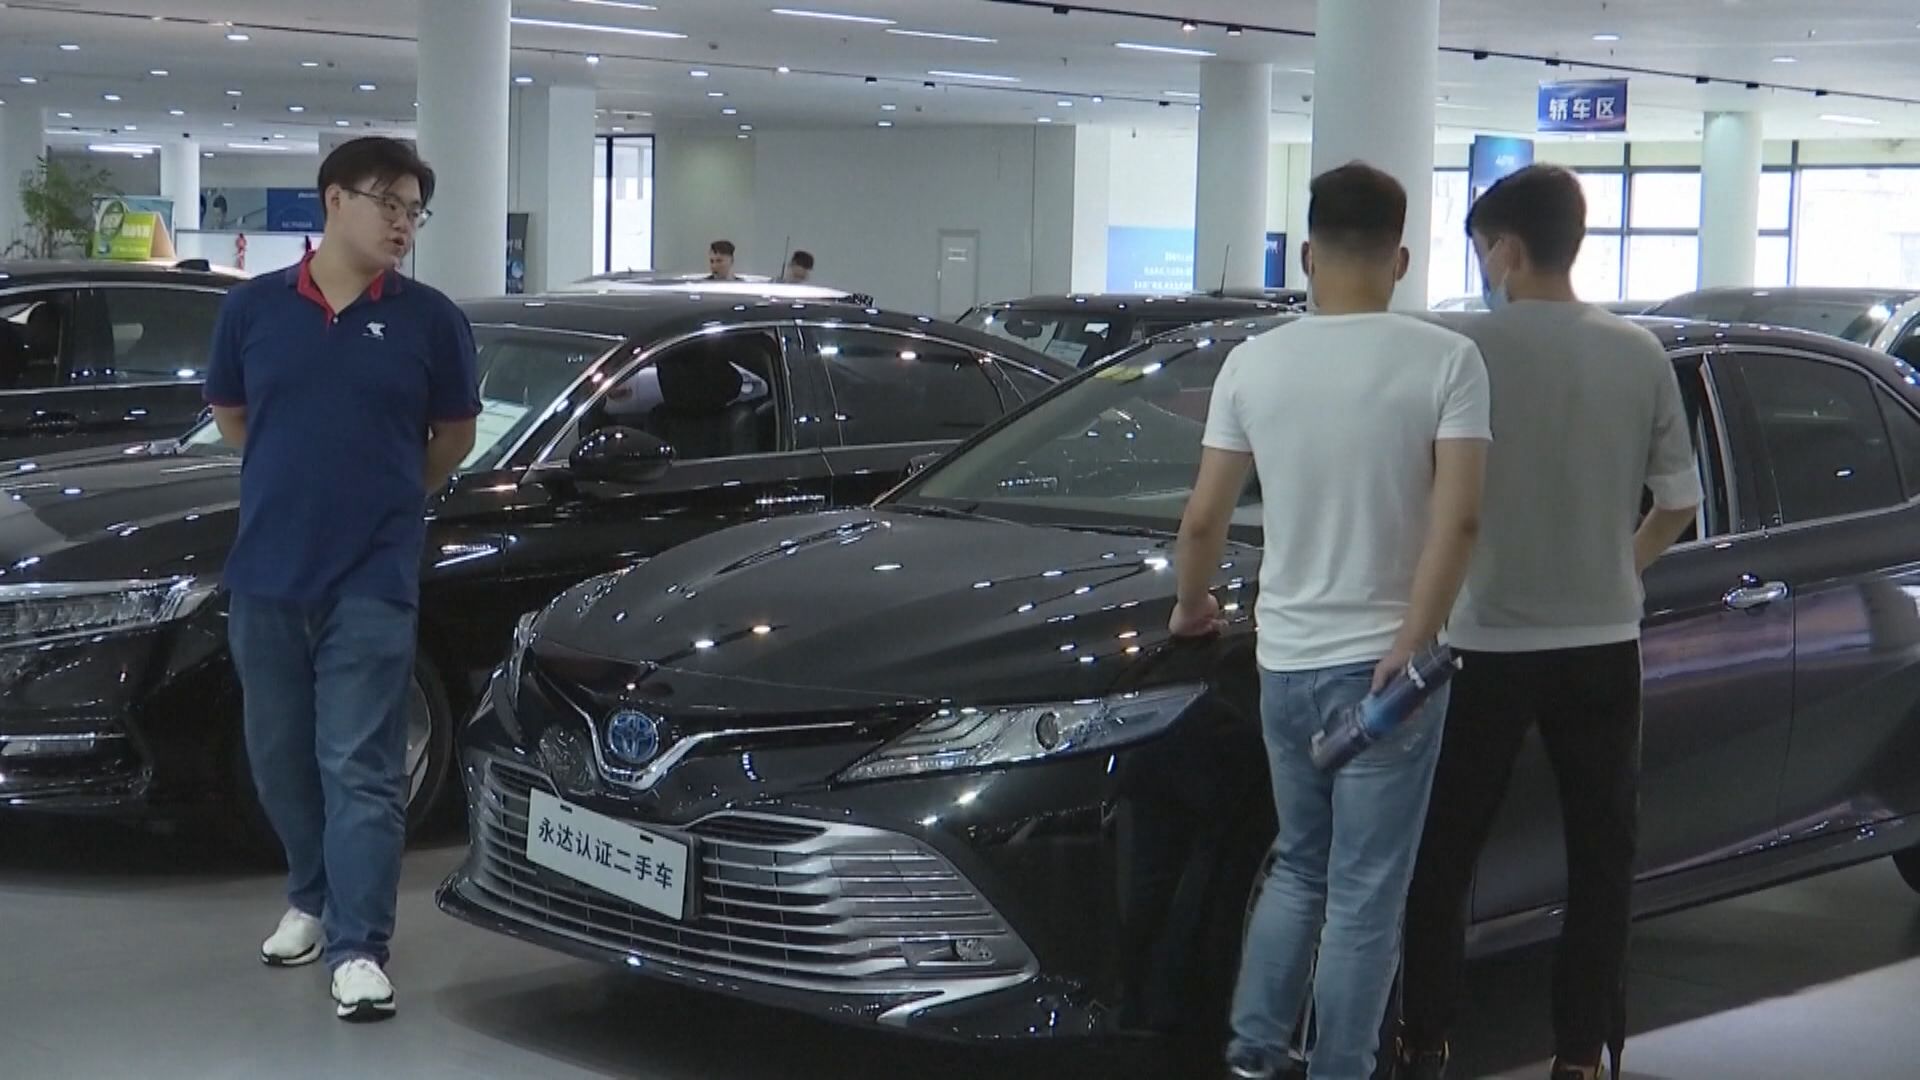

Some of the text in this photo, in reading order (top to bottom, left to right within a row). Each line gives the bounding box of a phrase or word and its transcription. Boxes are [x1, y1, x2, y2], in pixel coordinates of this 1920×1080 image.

[1549, 97, 1615, 121] 轿车区
[538, 817, 674, 890] 永达认证二手车
